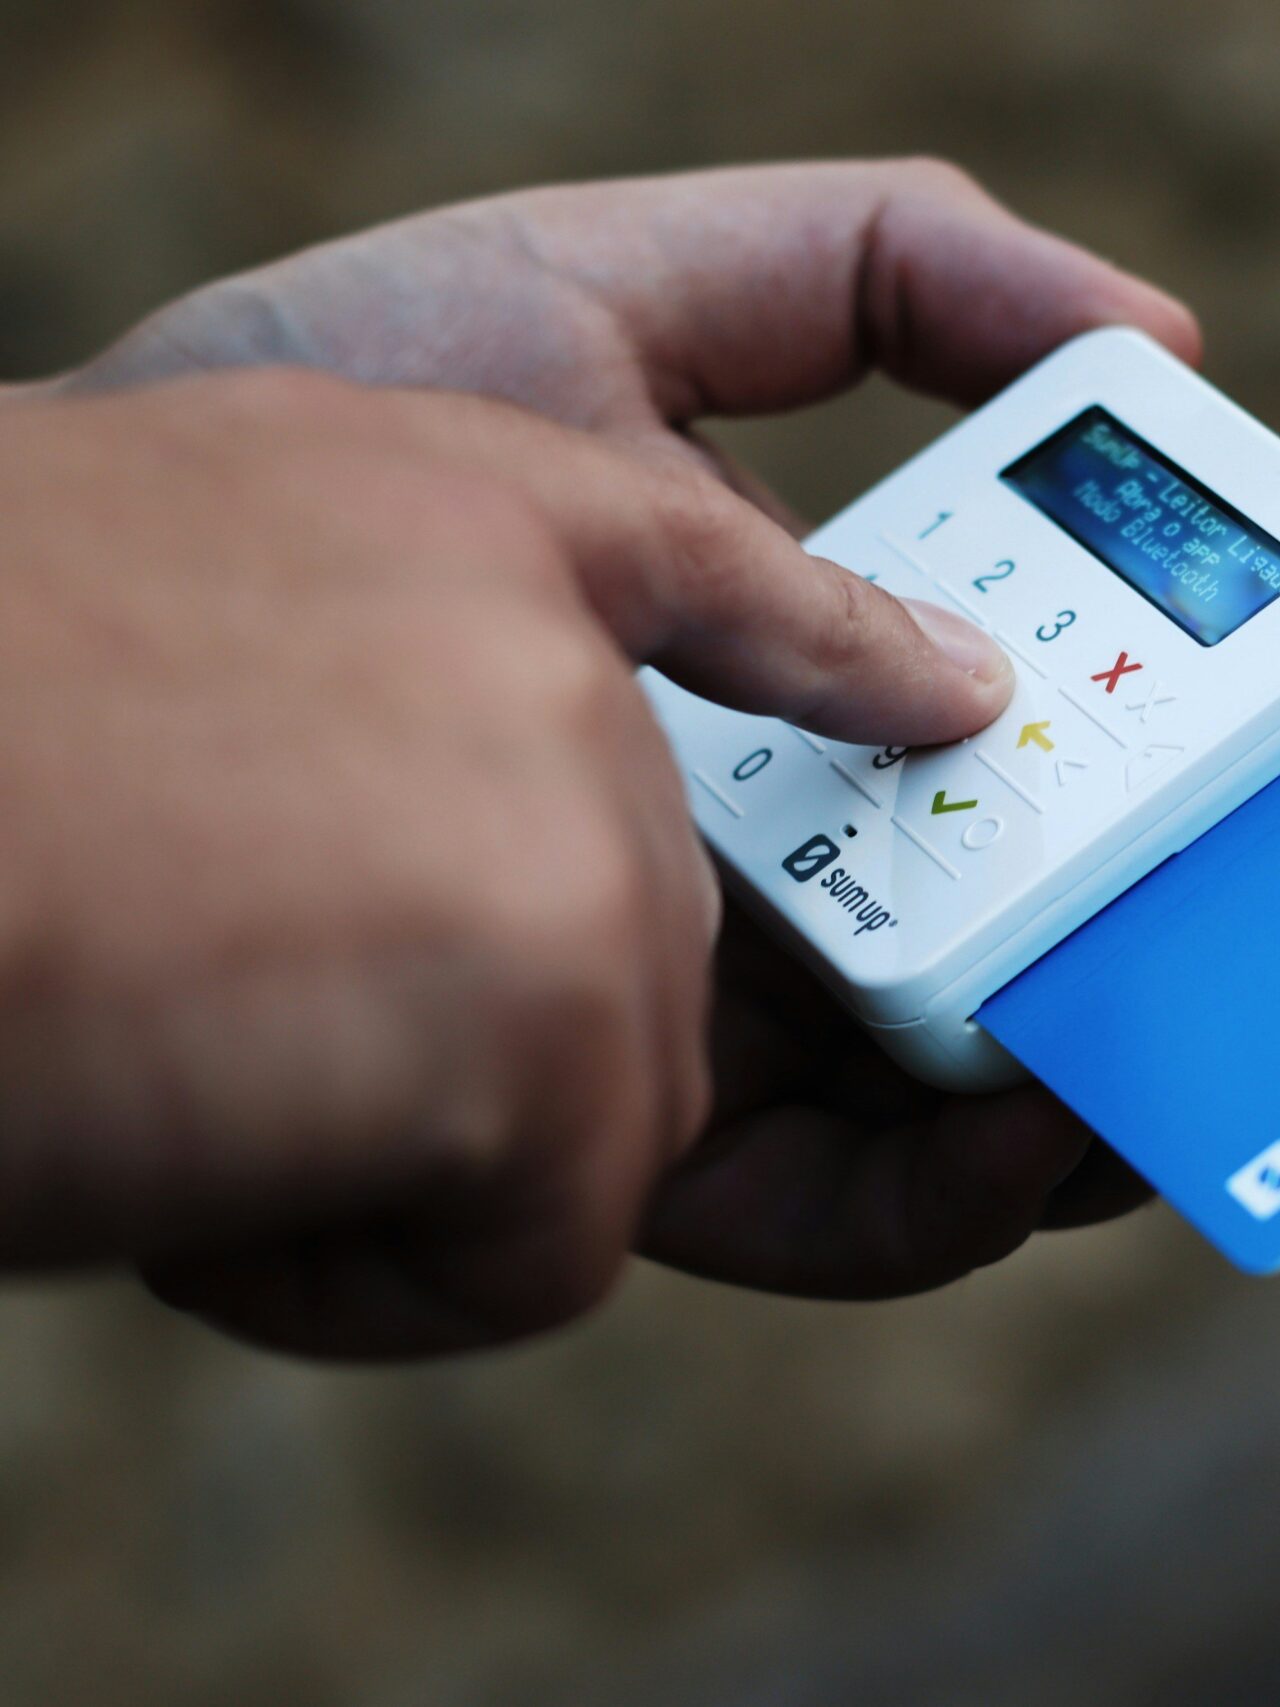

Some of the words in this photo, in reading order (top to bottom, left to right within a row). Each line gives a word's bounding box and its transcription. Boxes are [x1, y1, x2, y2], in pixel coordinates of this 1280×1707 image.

[917, 511, 955, 540] 1
[1158, 480, 1228, 537] Leitor
[1073, 480, 1121, 523] Modo
[1120, 517, 1220, 602] Bluetooth
[1162, 521, 1181, 538] o
[972, 559, 1016, 594] 2
[1036, 609, 1077, 643] 3
[732, 747, 773, 782] 0
